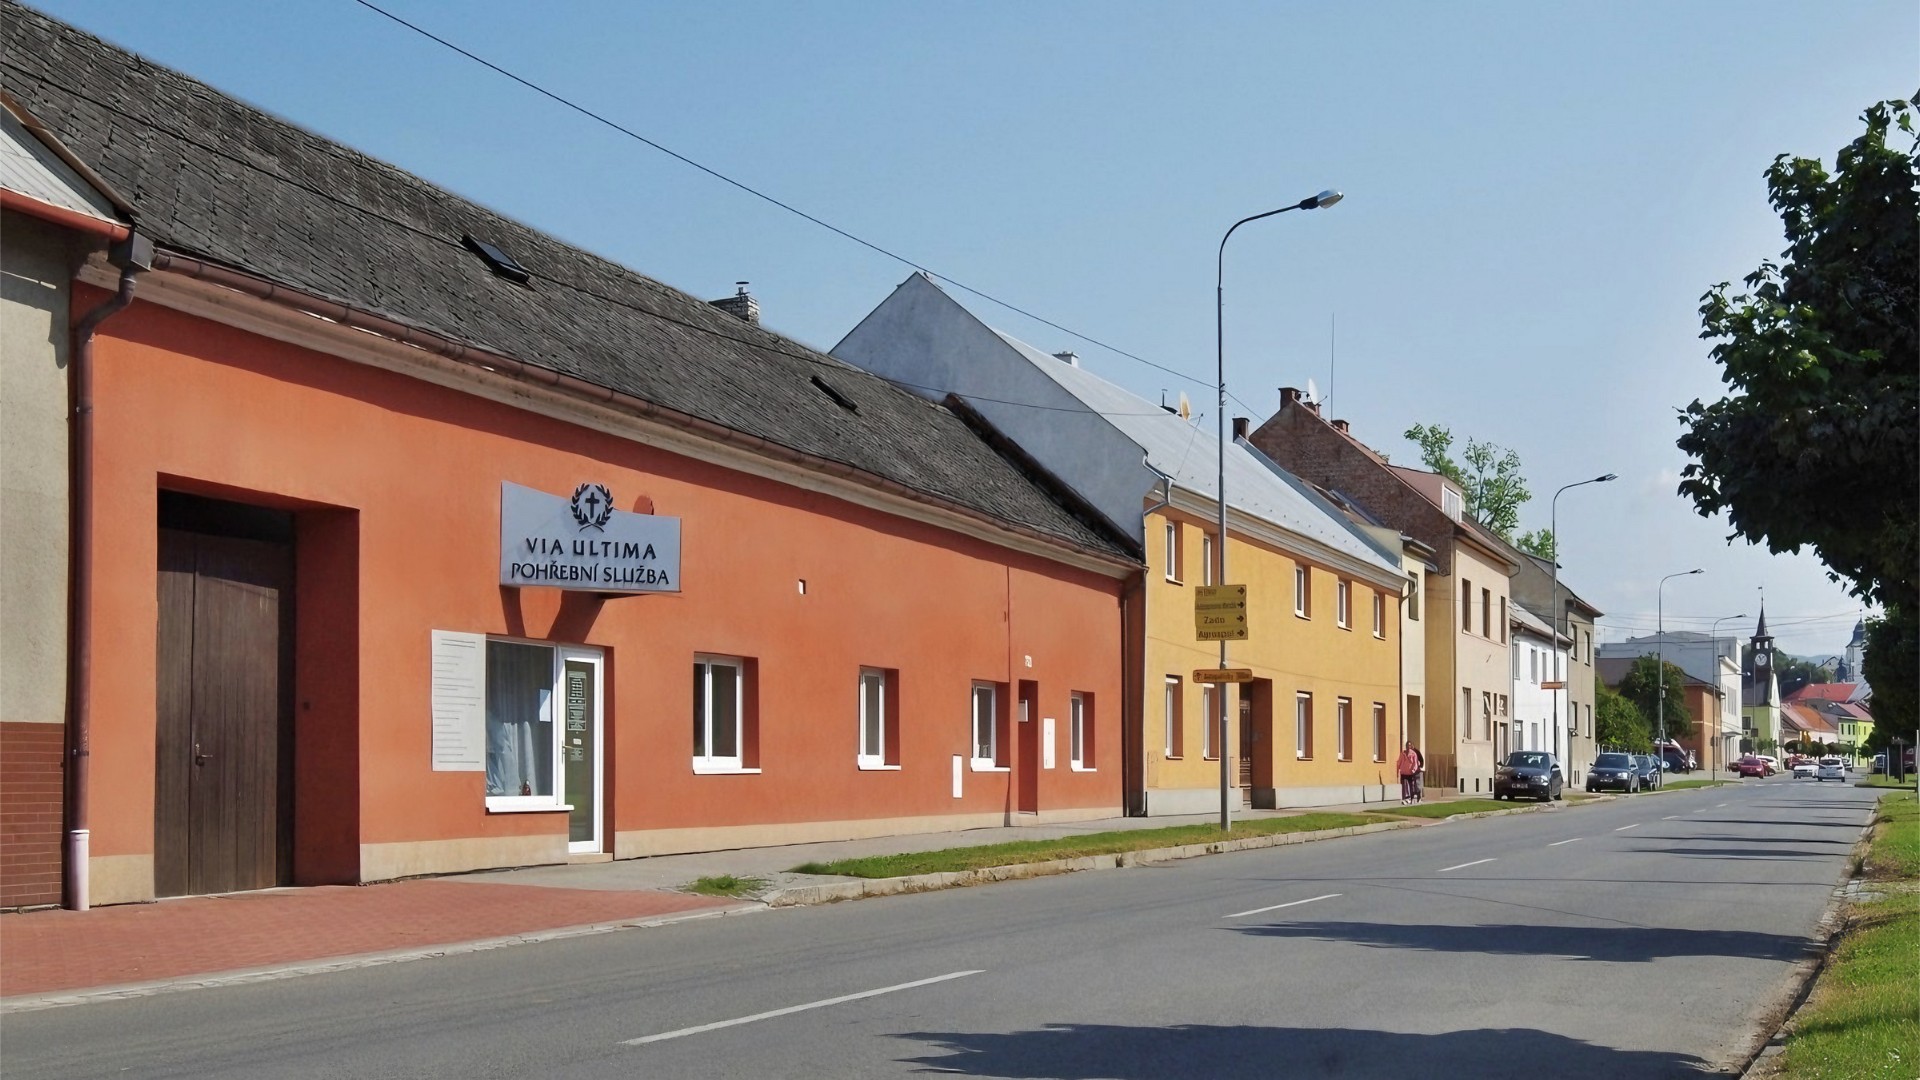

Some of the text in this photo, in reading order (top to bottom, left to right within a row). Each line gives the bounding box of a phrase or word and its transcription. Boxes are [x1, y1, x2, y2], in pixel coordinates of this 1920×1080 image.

[526, 538, 656, 559] VIA ULTIMA
[511, 560, 669, 585] POHŘEBNÍ SLUŽBA
